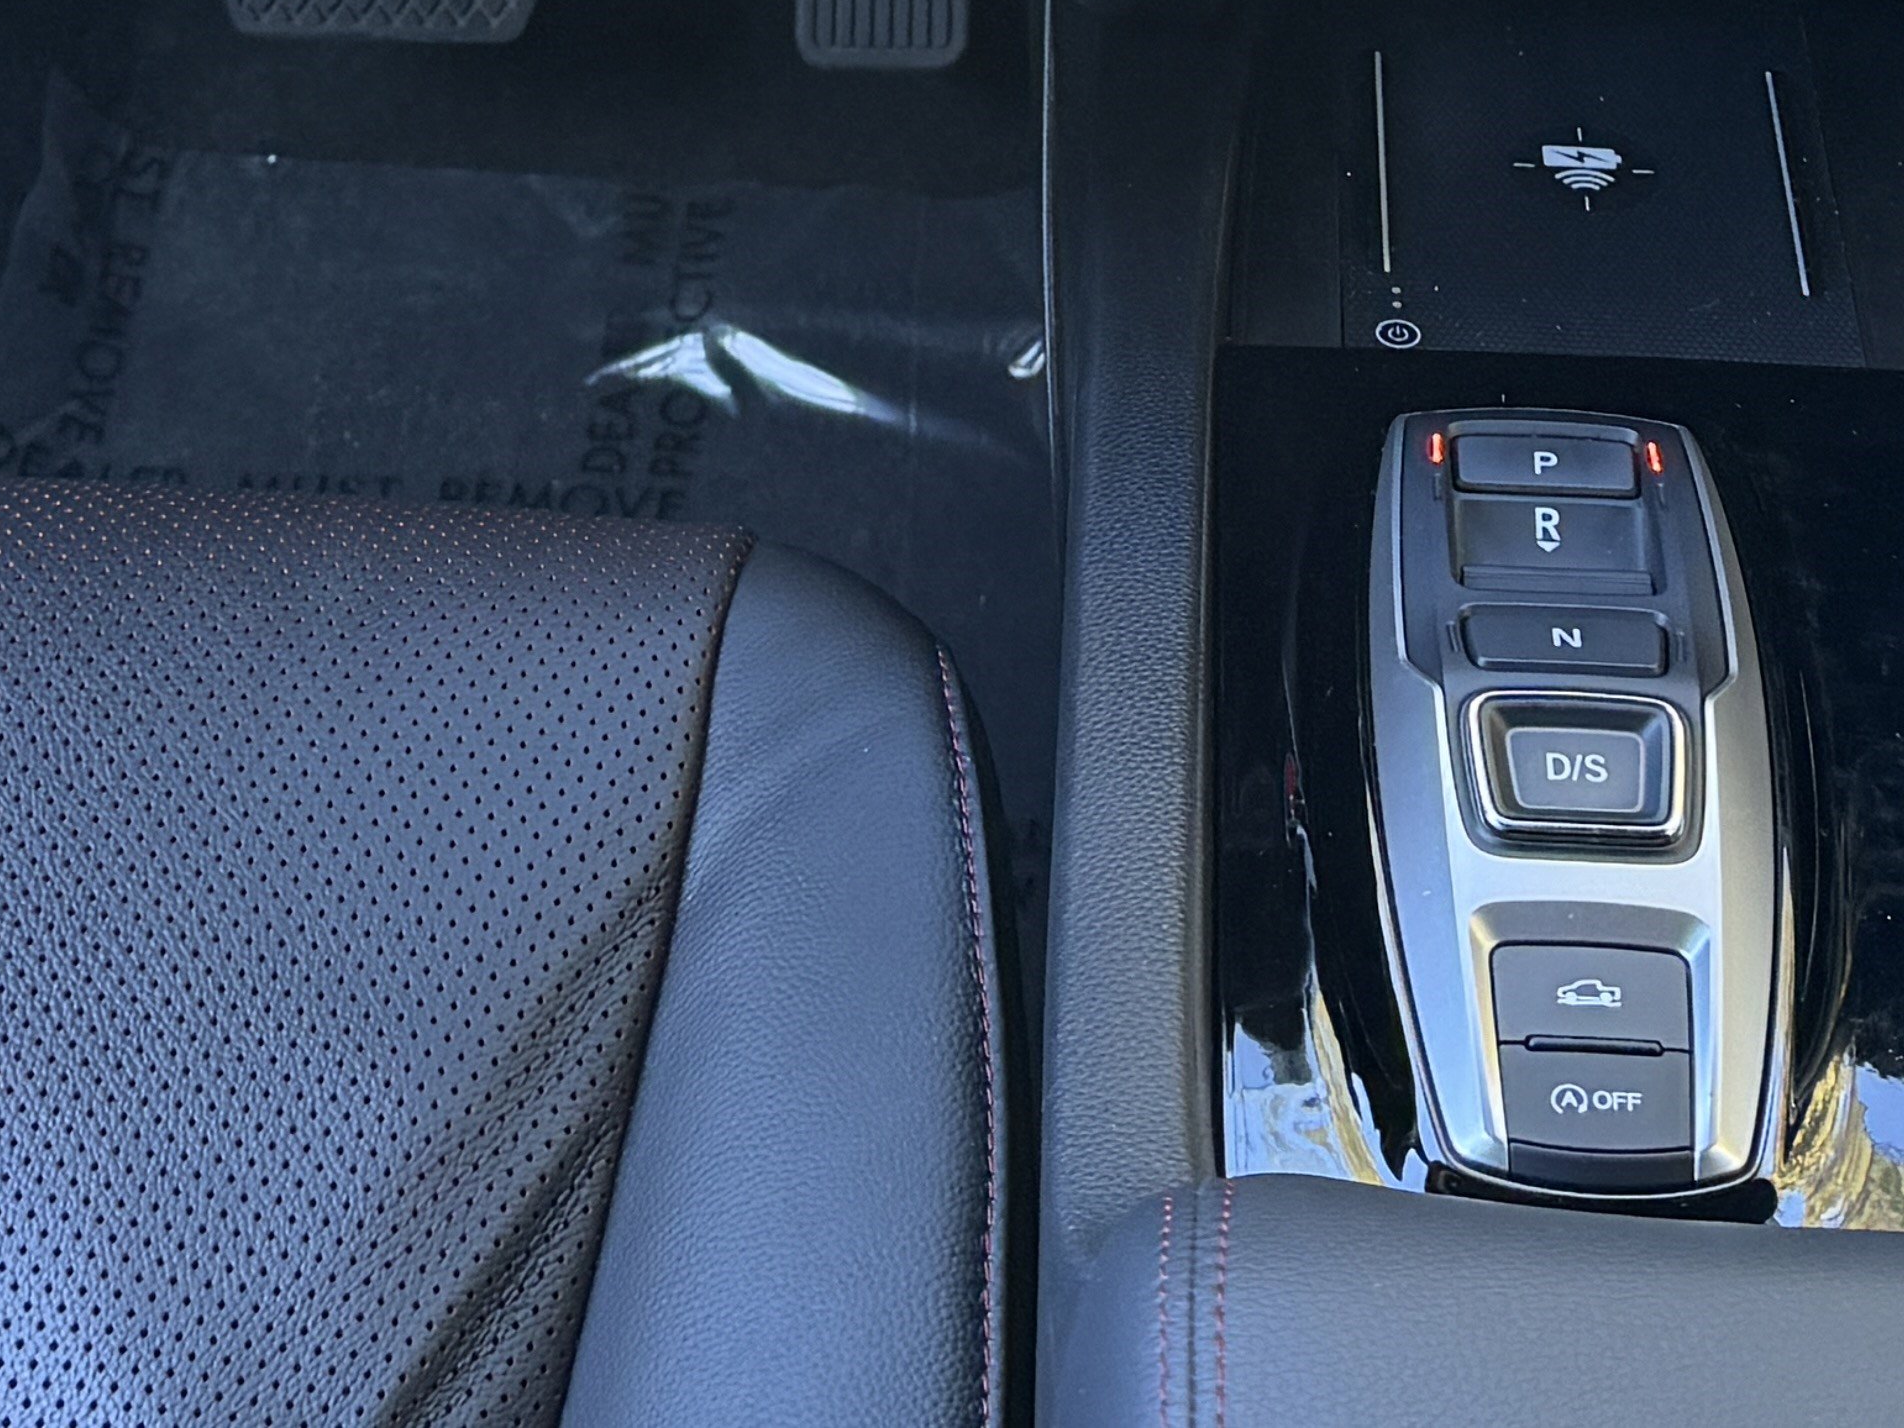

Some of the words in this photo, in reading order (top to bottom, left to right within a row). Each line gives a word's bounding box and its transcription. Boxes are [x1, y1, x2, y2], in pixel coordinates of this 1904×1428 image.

[1534, 452, 1557, 475] P
[1535, 507, 1561, 541] R
[1552, 628, 1582, 647] N
[1546, 753, 1608, 782] D/S
[1593, 1091, 1642, 1111] OFF
